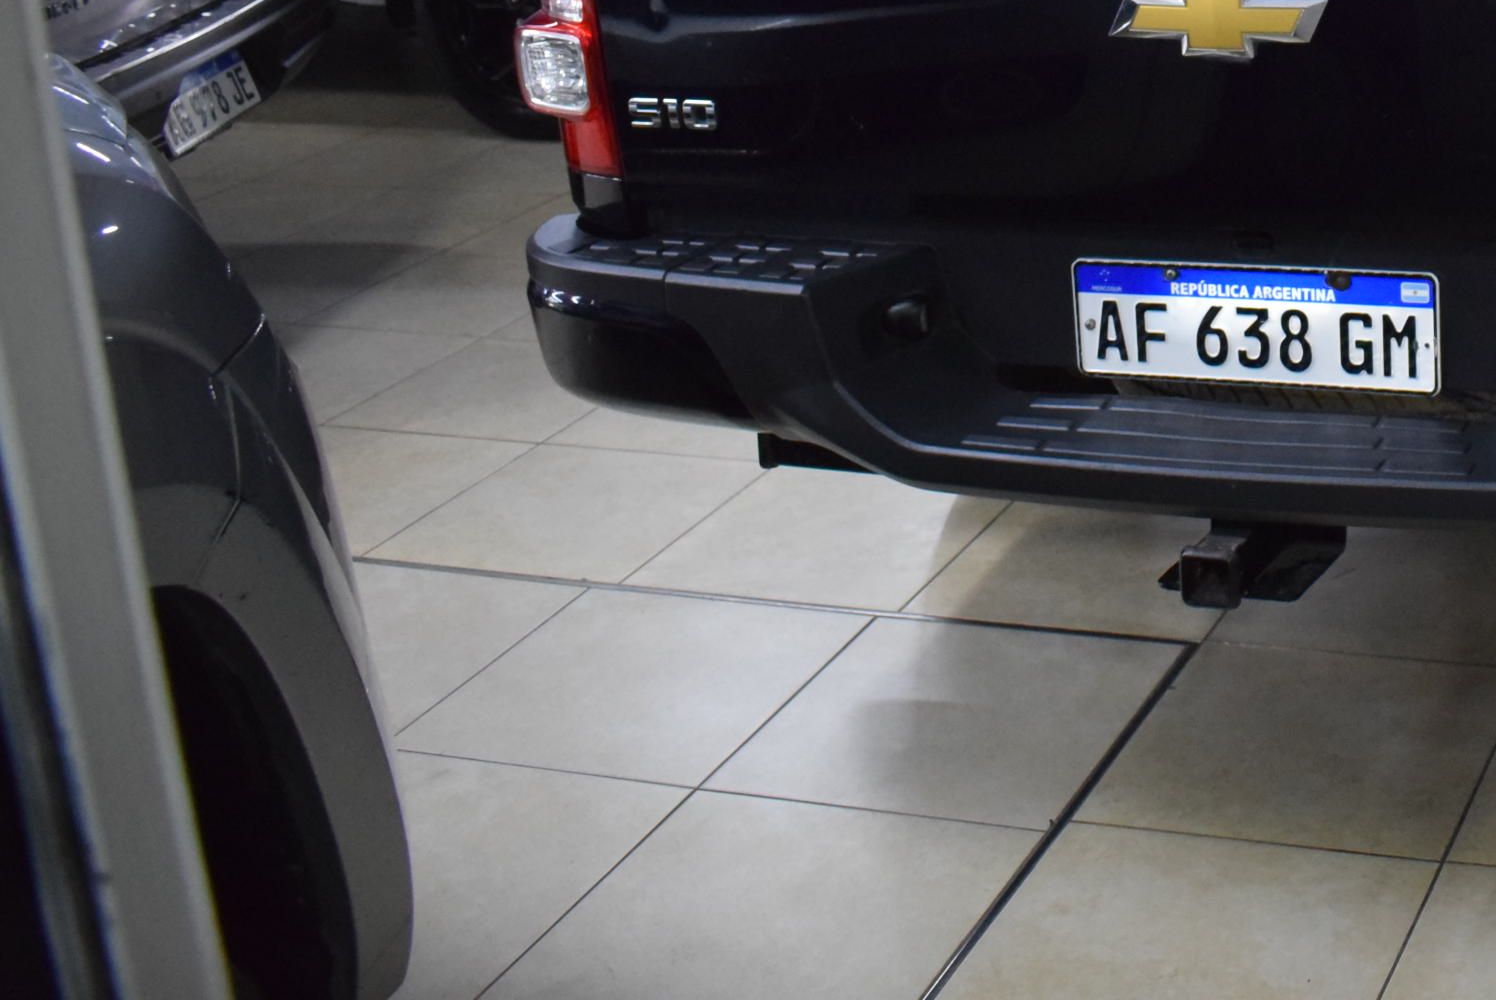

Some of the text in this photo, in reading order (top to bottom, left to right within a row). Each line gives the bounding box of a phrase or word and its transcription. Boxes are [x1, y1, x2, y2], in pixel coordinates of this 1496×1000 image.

[225, 65, 255, 106] JE
[627, 97, 718, 131] S10
[1170, 280, 1337, 302] REPÚBLICA ARGENTINA
[1096, 299, 1418, 380] AF 638 GM
